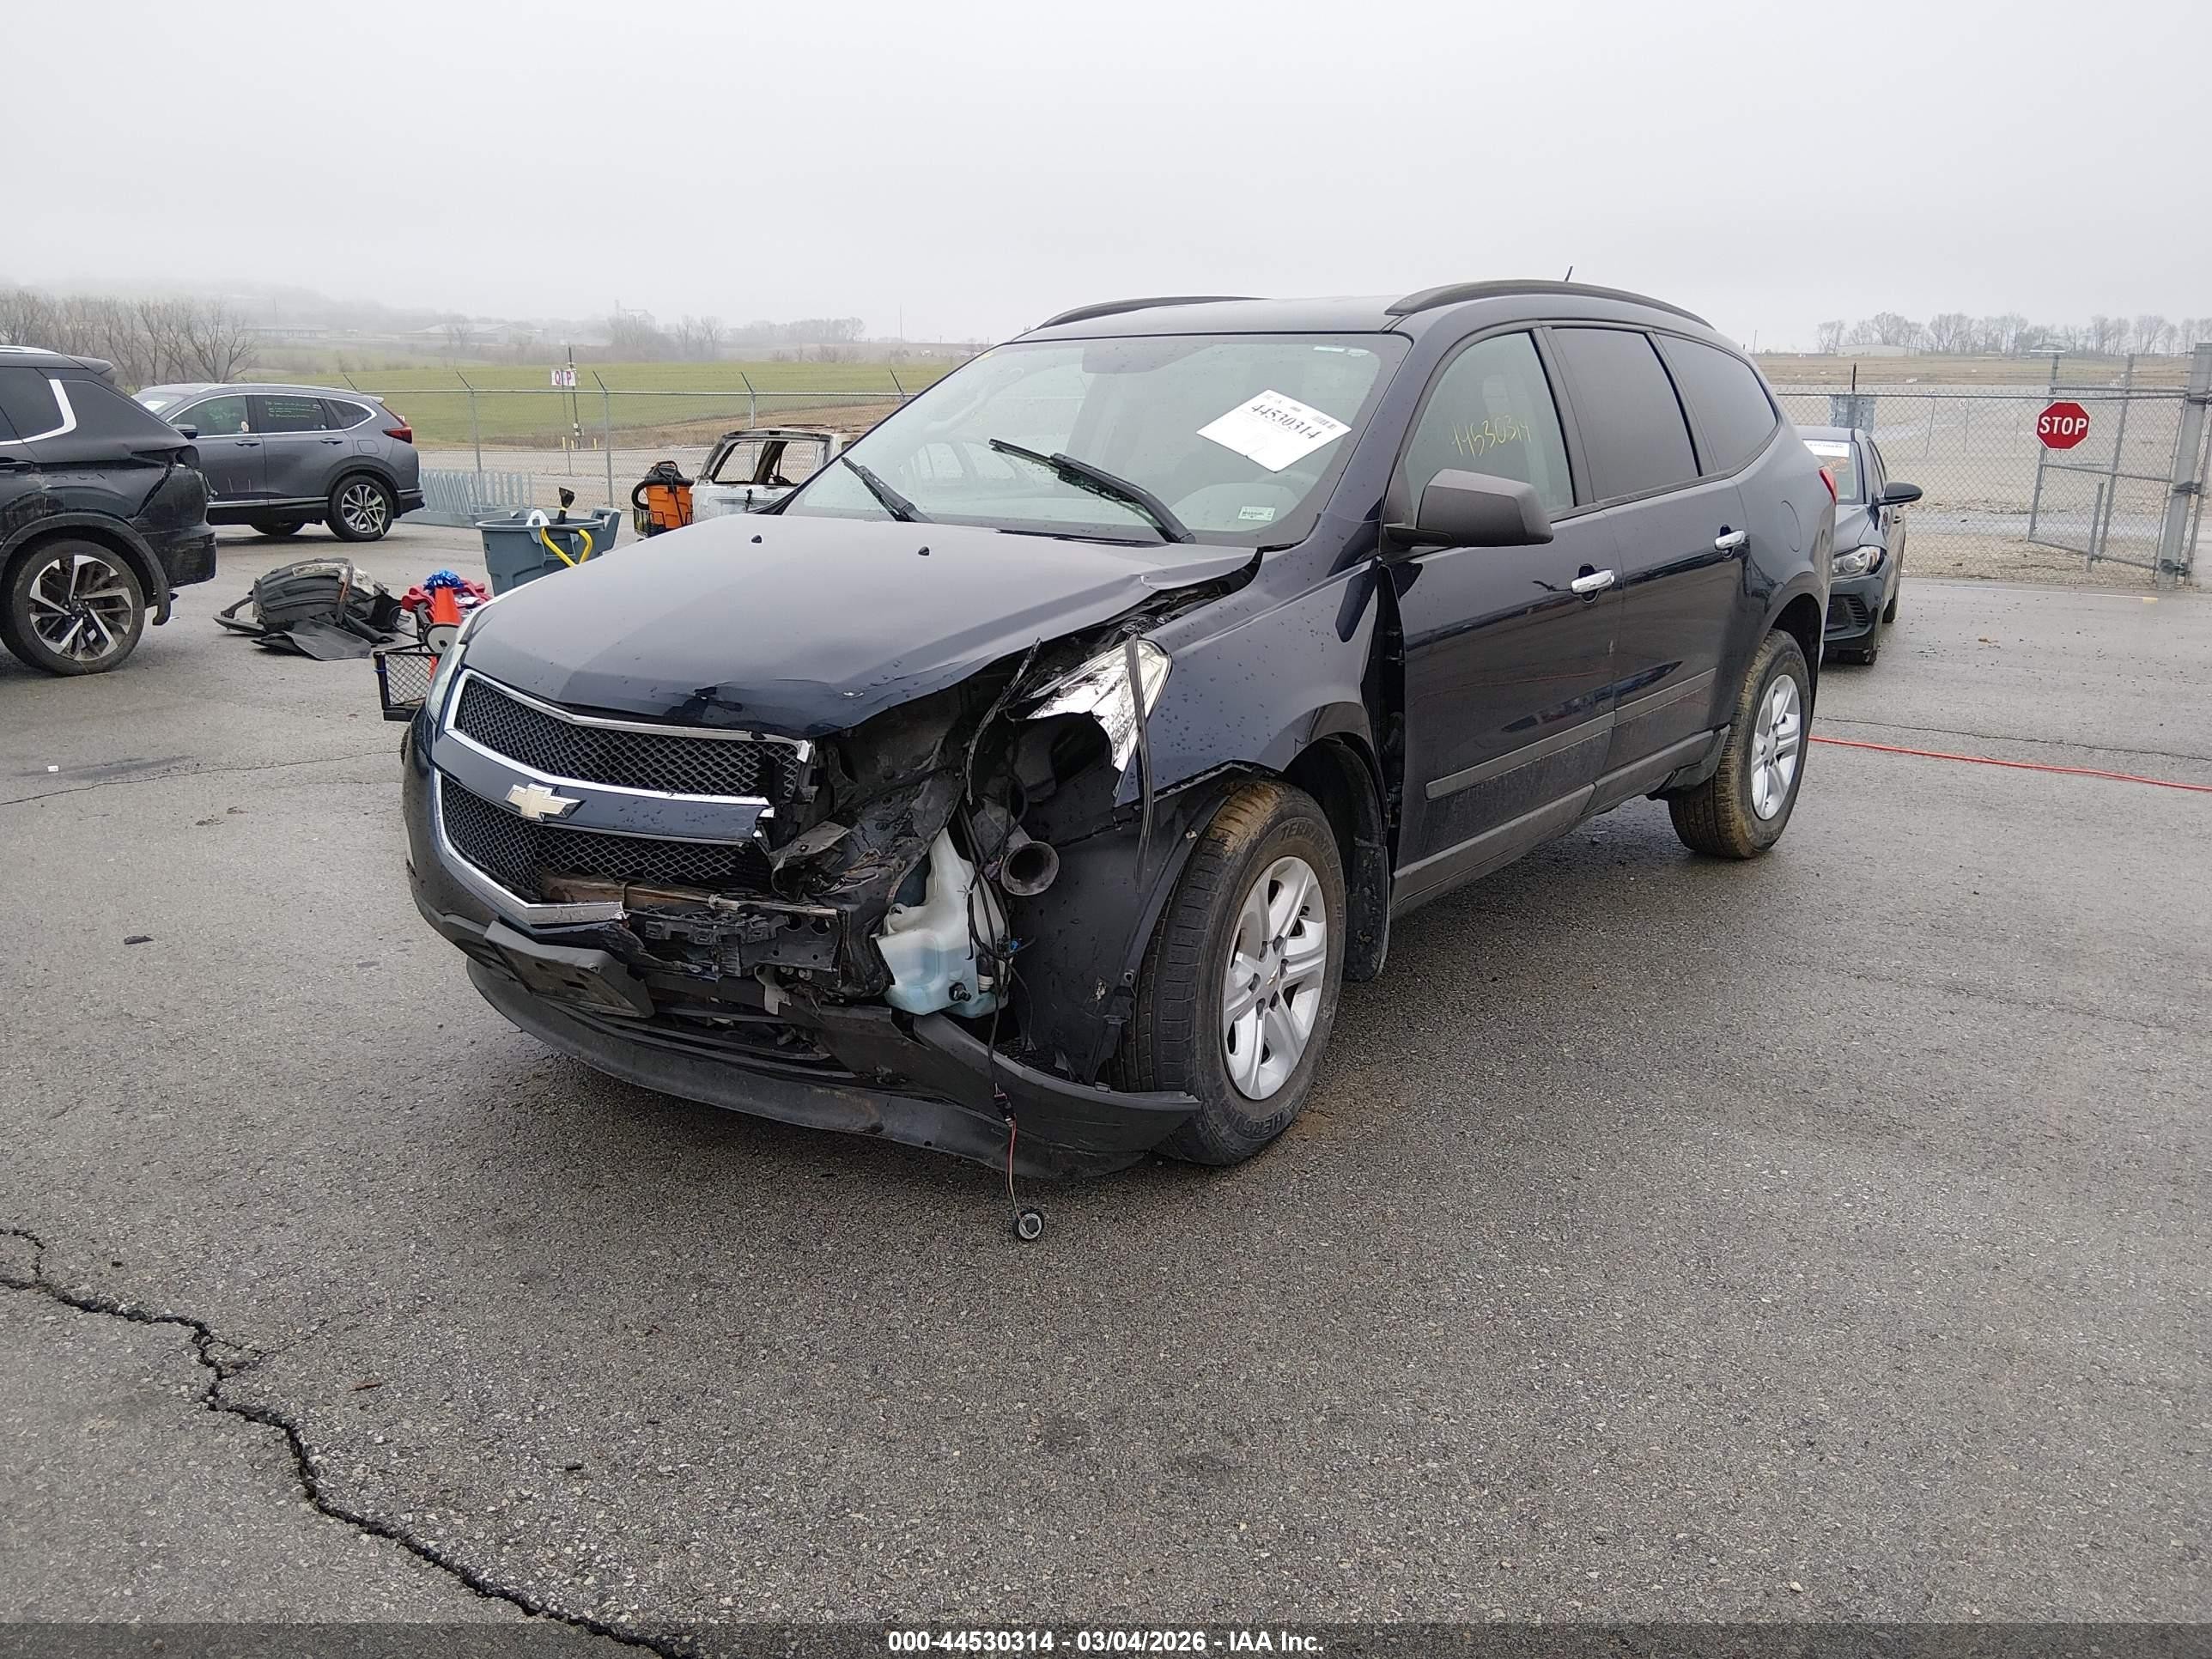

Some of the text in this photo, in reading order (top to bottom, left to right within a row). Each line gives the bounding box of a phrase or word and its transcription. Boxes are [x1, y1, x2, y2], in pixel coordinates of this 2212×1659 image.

[1251, 404, 1322, 440] 44530314
[1451, 416, 1531, 460] 44530314
[2039, 416, 2087, 435] STOP
